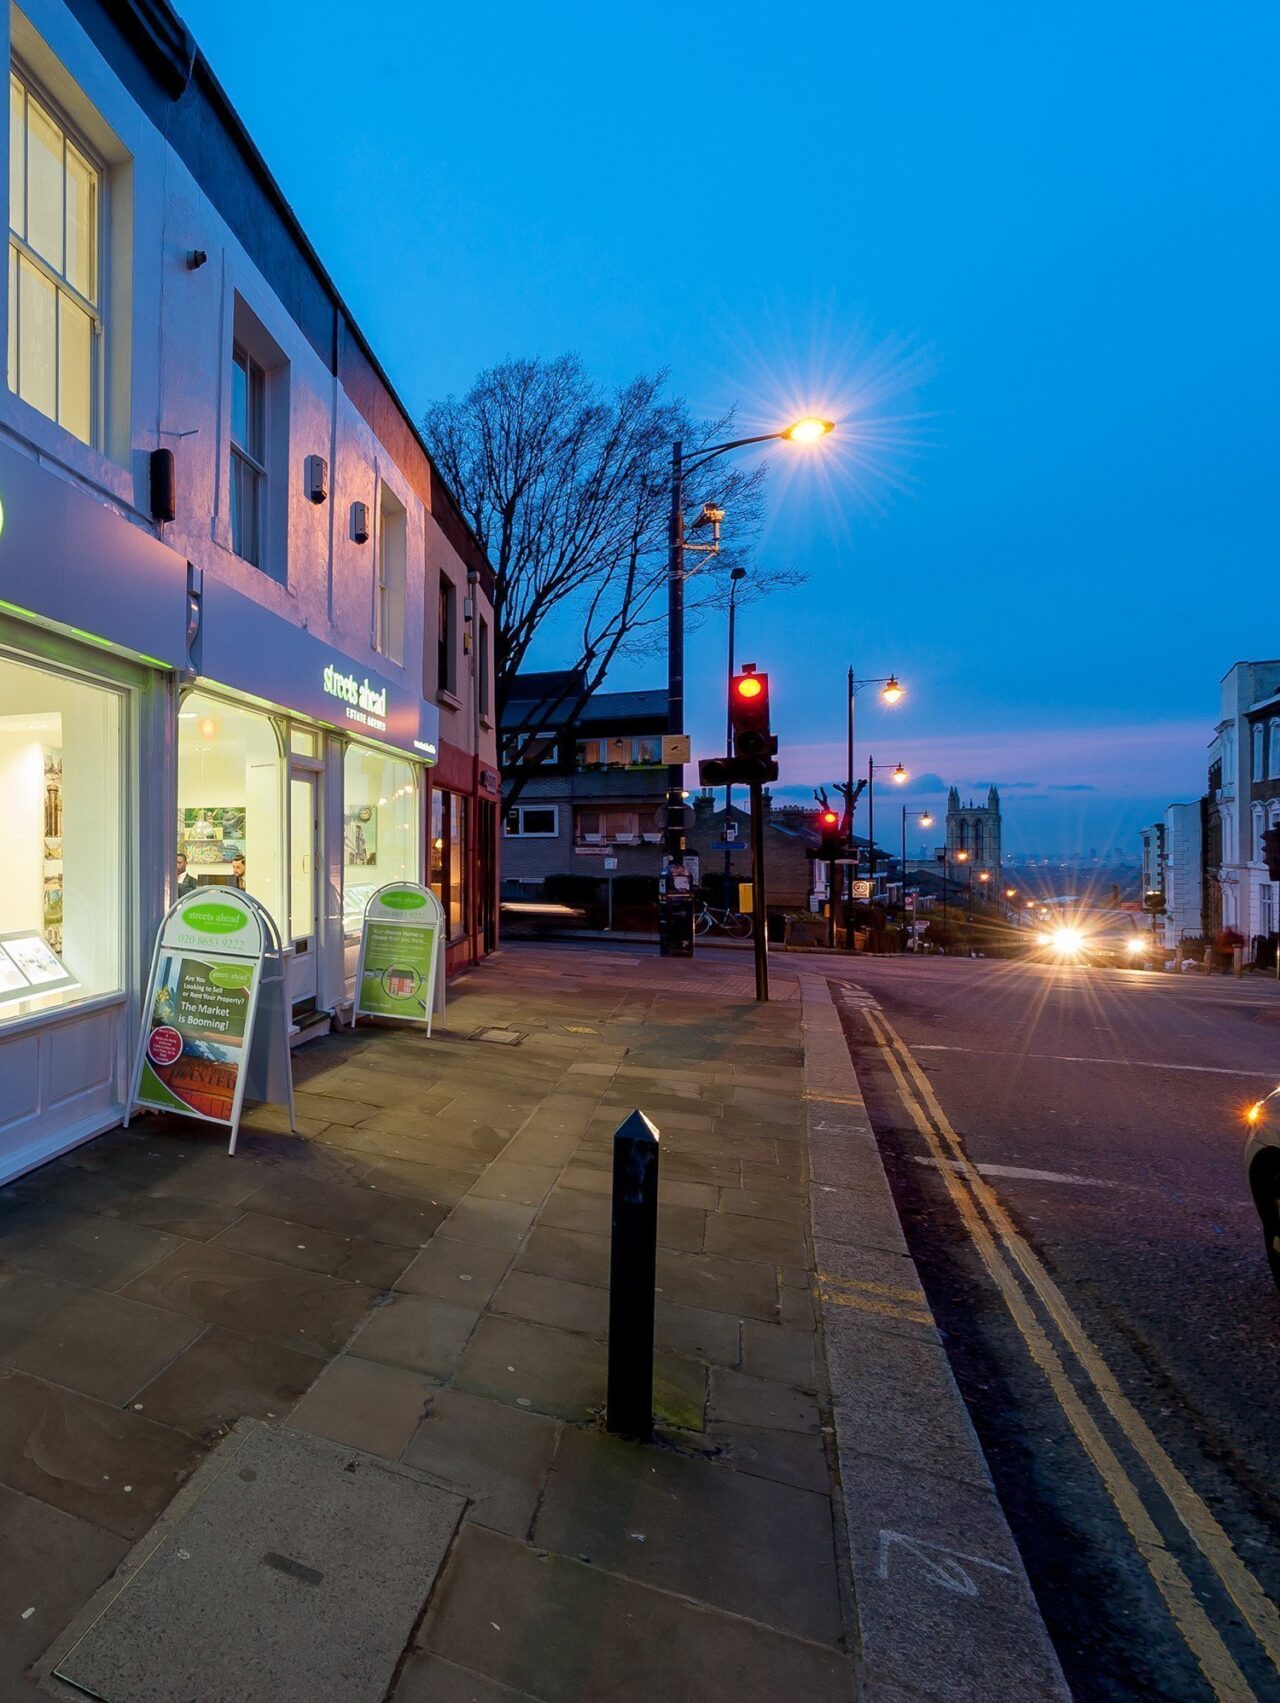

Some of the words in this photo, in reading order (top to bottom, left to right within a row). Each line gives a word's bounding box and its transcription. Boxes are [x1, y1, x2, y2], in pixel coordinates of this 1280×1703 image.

[323, 664, 358, 706] streets
[359, 678, 386, 717] ahead
[188, 912, 215, 921] streets
[215, 913, 240, 924] ahead
[178, 935, 195, 944] 020
[197, 936, 219, 947] 8653
[221, 938, 244, 949] 9222
[183, 983, 205, 992] Looking
[190, 991, 203, 999] Rent
[203, 993, 217, 1001] Your
[217, 995, 245, 1005] Property?
[181, 1001, 197, 1012] The
[198, 1004, 230, 1017] Market
[178, 1013, 186, 1023] is
[187, 1015, 229, 1031] Booming!
